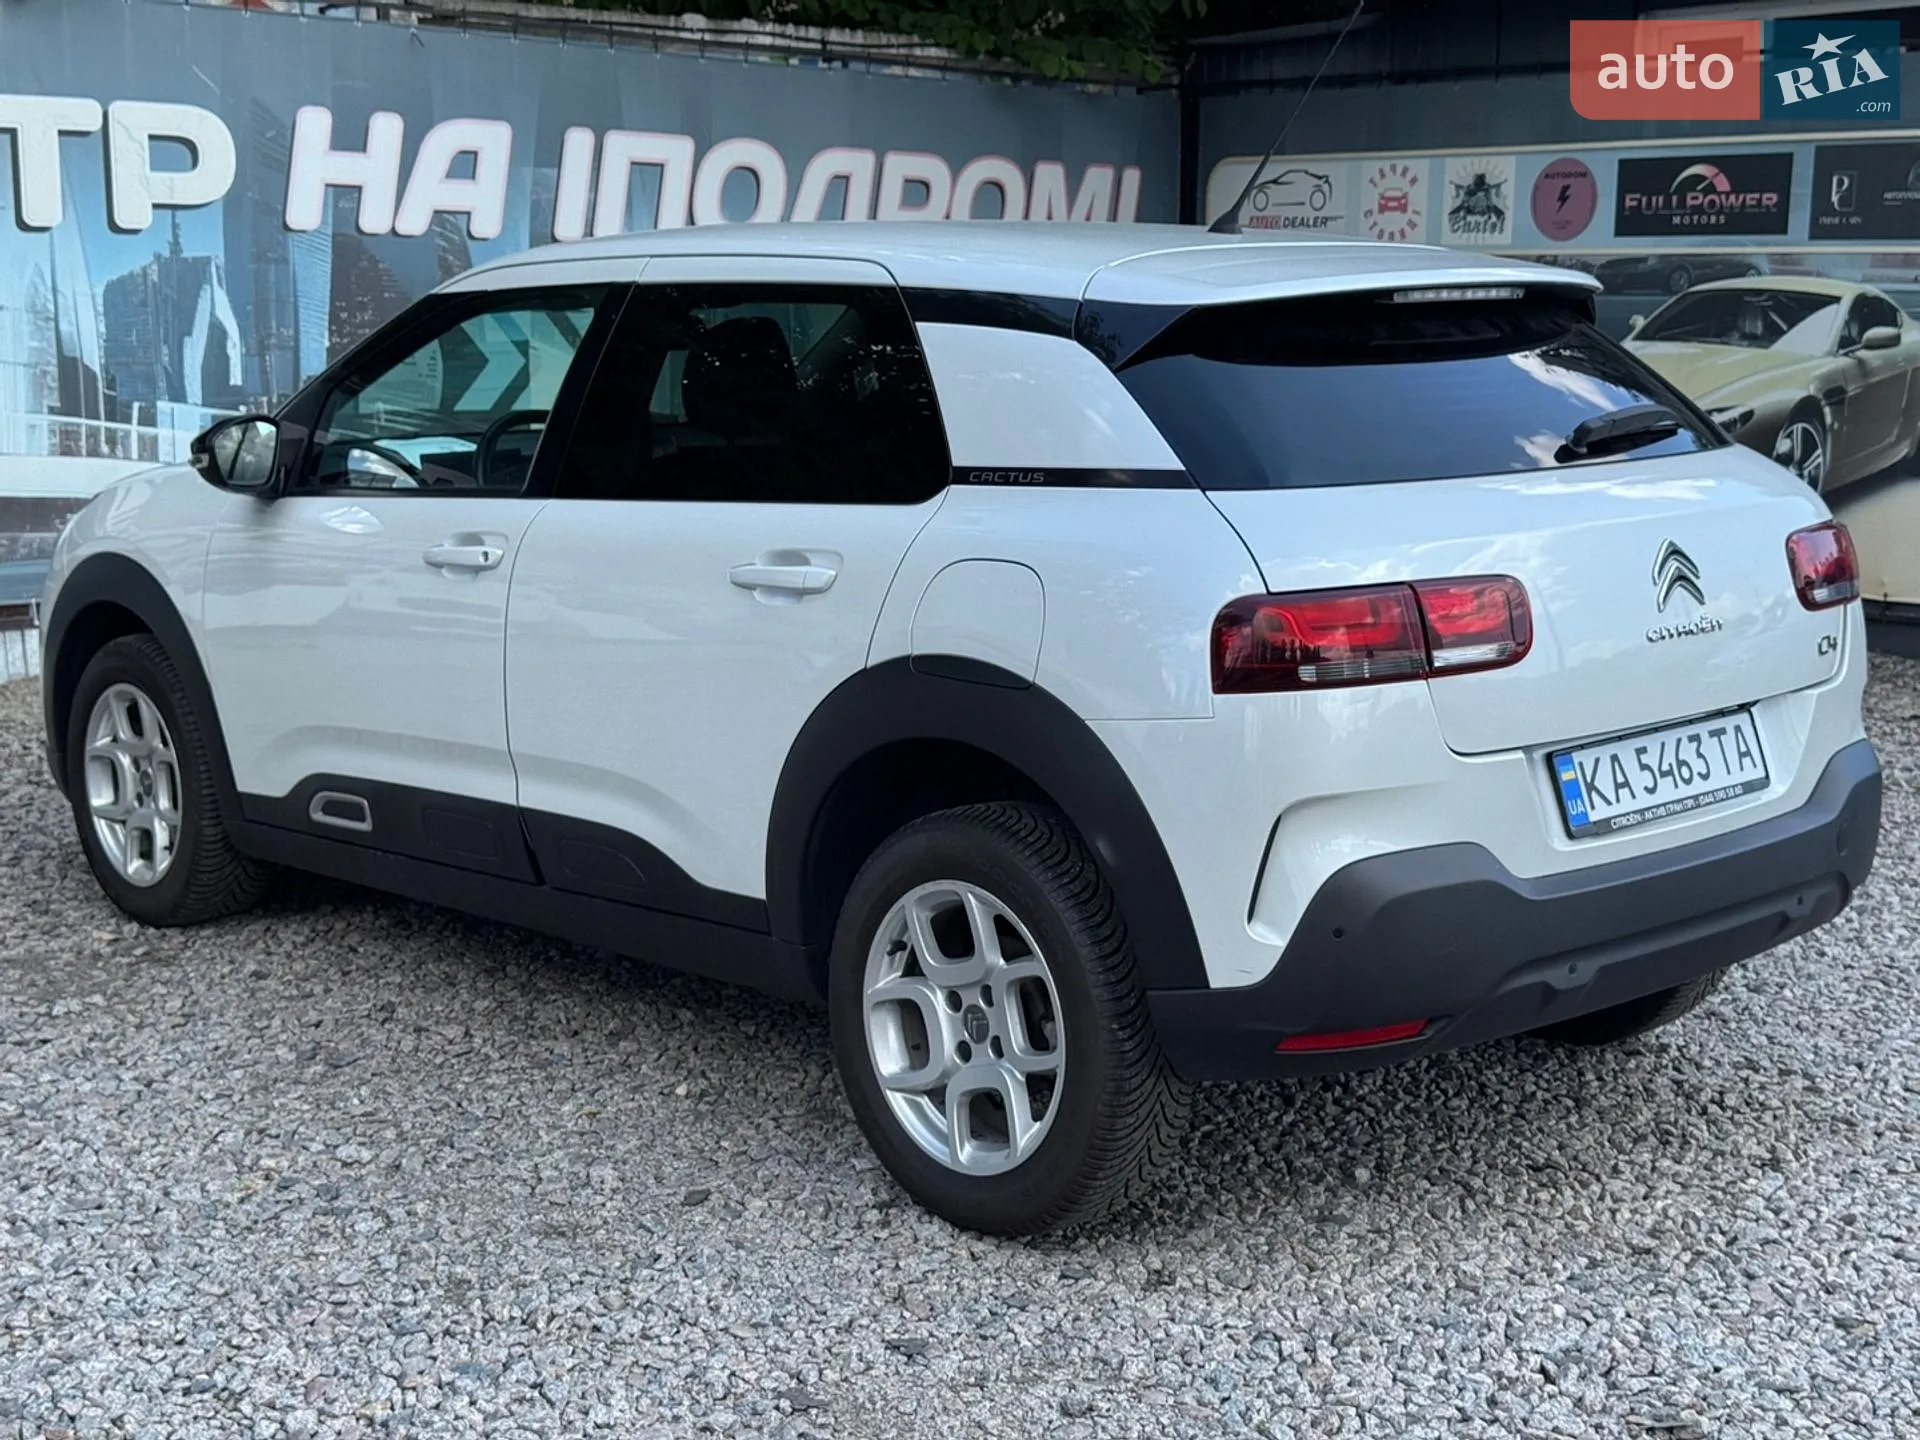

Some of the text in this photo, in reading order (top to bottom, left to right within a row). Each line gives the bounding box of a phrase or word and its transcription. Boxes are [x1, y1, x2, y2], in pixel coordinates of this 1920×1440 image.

[285, 105, 513, 239] НА
[1282, 215, 1329, 229] DEALER
[1672, 214, 1726, 225] MOTORS
[969, 471, 1045, 483] CACTUS
[1817, 634, 1838, 656] C4
[1634, 732, 1711, 796] 5463
[1568, 799, 1586, 816] UA
